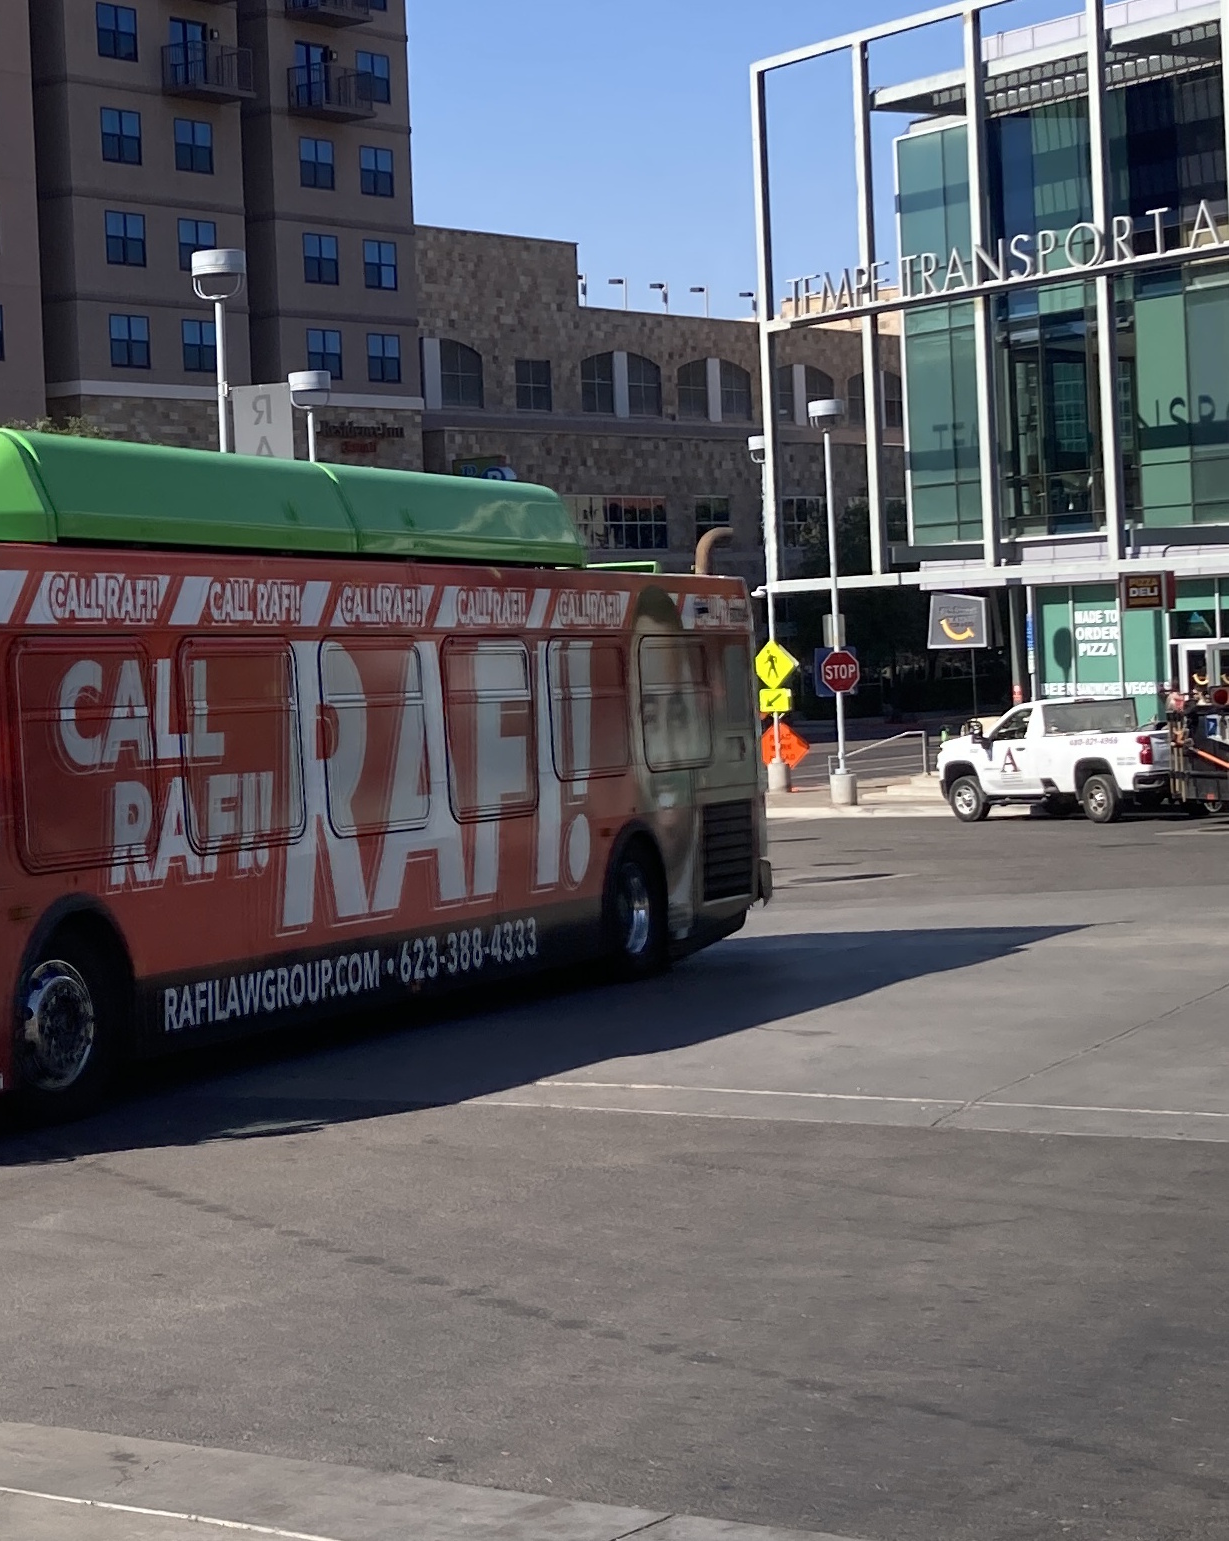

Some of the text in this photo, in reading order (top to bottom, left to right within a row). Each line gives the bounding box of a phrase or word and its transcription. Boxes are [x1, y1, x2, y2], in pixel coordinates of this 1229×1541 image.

[49, 574, 159, 620] CALL RAFI!
[209, 580, 301, 622] CALL RAFI!
[341, 583, 380, 624] CALL
[457, 588, 490, 625] CALL
[557, 590, 589, 626] CALL
[1129, 587, 1158, 597] DELI
[1074, 610, 1119, 624] MADE TO
[1075, 626, 1119, 640] ORDER
[1079, 643, 1116, 656] PIZZA
[825, 664, 856, 679] STOP
[57, 658, 225, 768] CALL
[279, 640, 591, 929] RAFI!
[108, 772, 273, 889] RAFI!
[163, 916, 538, 1032] RAFILAWGROUP.COM 623-388-4333
